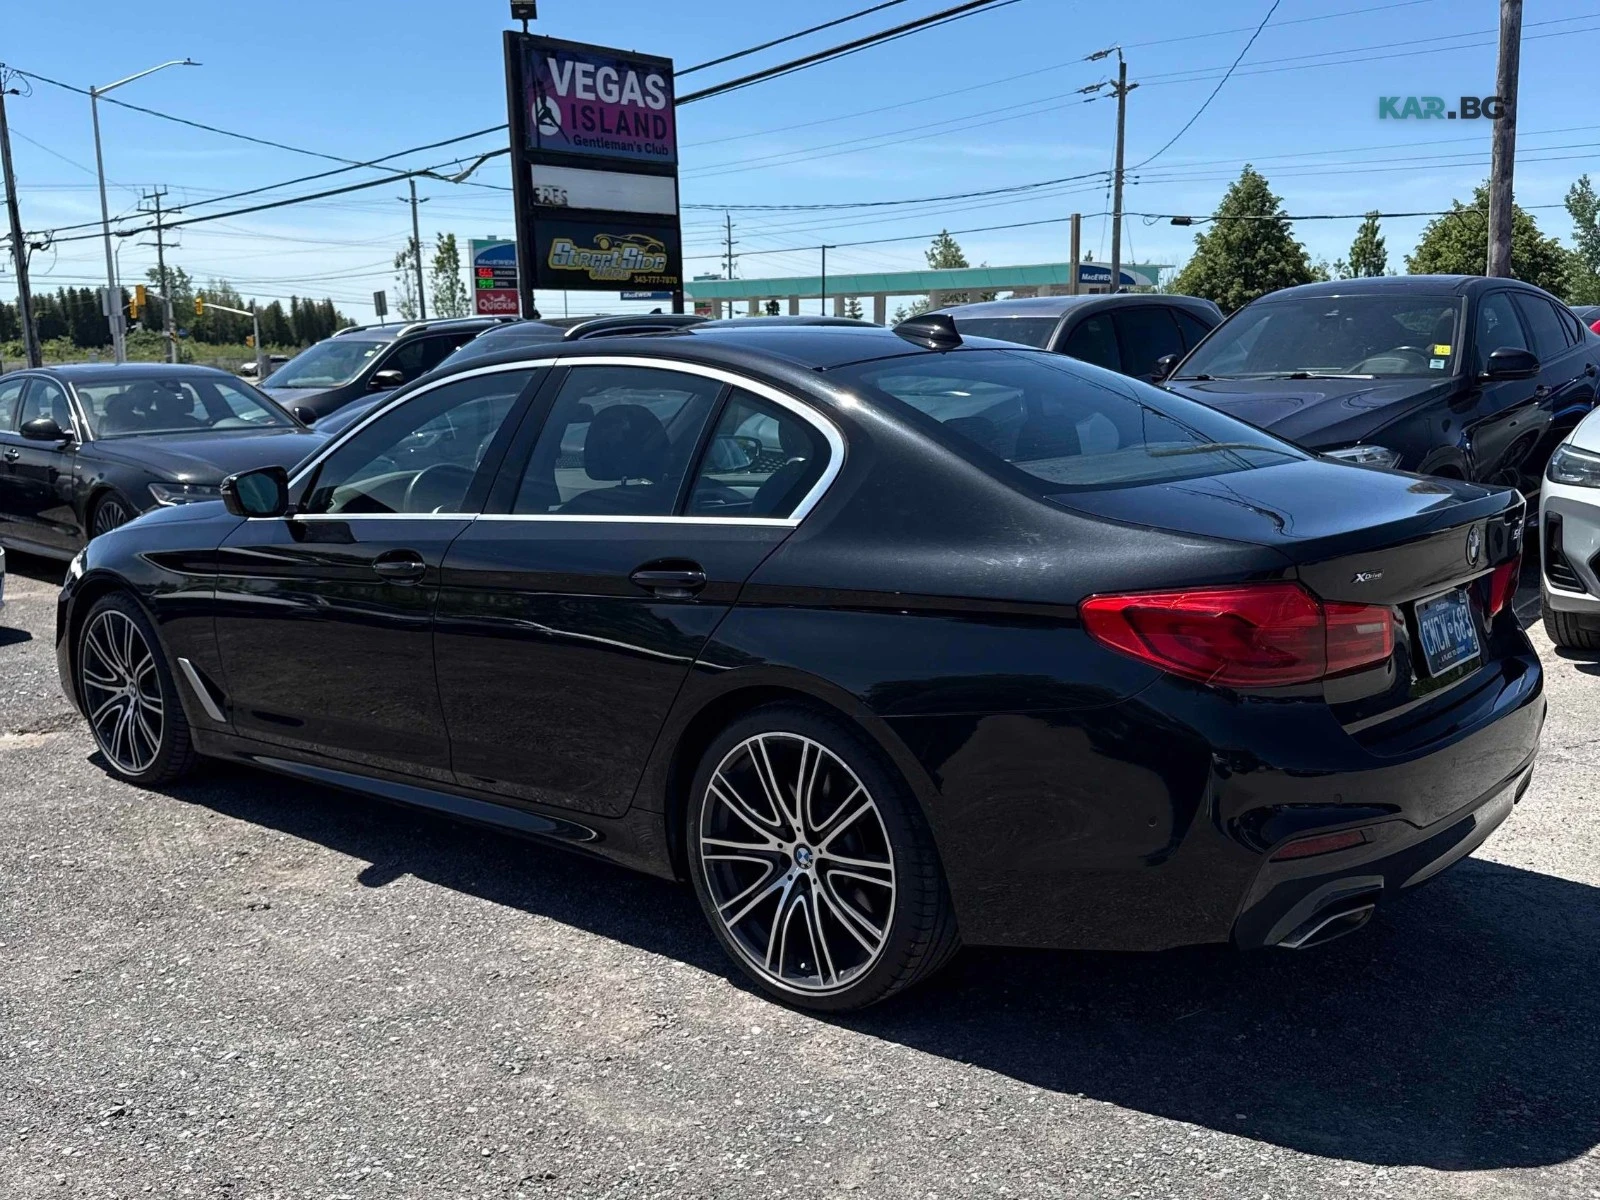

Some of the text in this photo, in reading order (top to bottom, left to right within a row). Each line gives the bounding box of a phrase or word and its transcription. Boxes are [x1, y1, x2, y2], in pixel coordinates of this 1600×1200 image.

[546, 57, 667, 110] VEGAS
[570, 103, 668, 141] ISLAND
[573, 134, 669, 156] Gentleman's Club
[478, 299, 517, 312] Quickie
